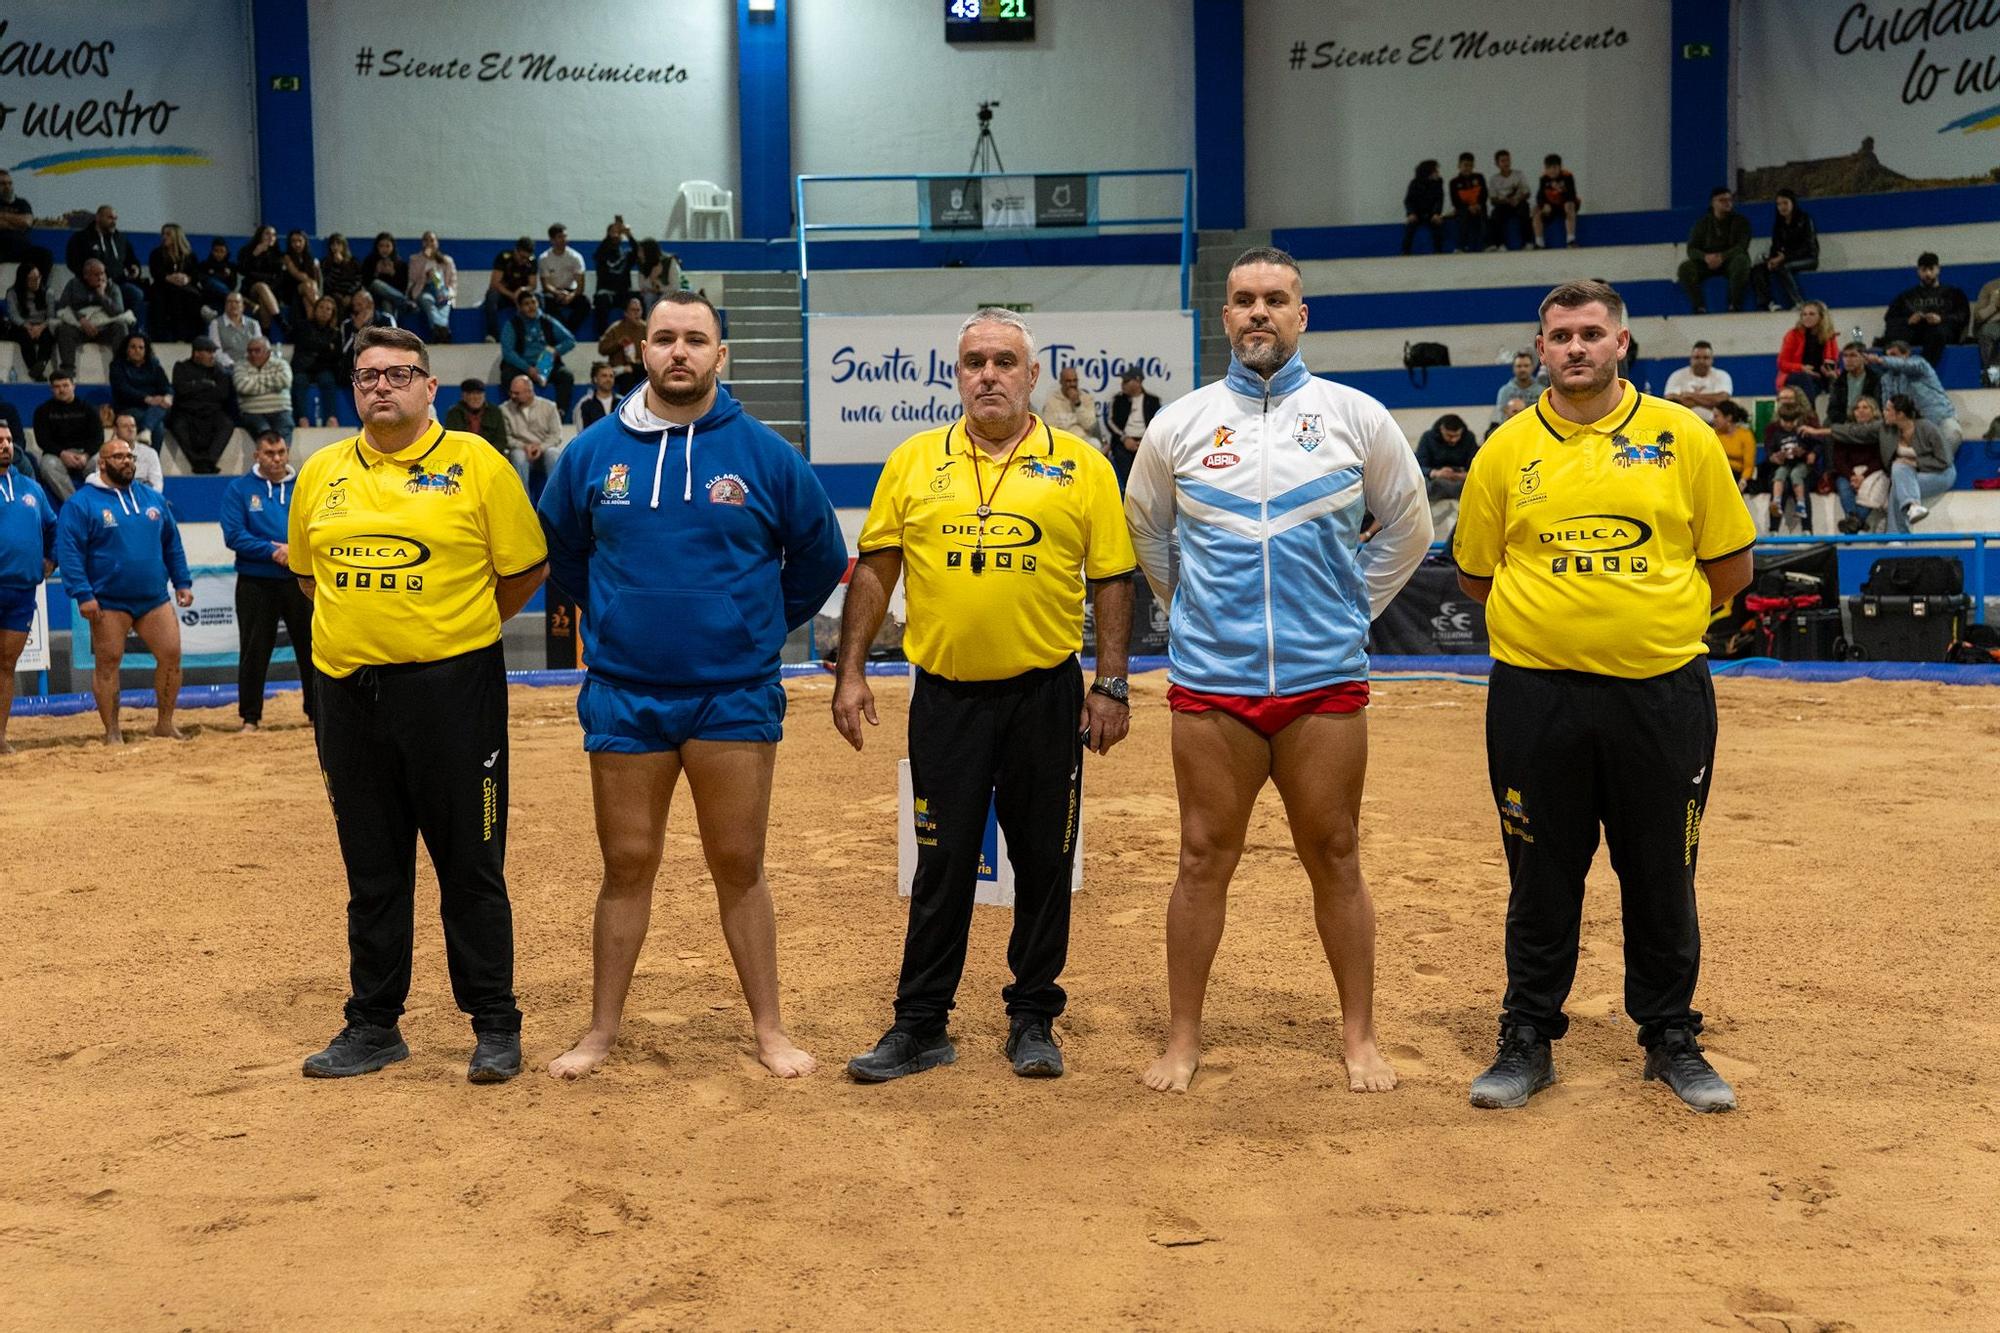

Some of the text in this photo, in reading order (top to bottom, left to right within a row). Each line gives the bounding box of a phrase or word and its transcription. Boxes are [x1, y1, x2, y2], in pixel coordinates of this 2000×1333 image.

[951, 0, 980, 18] 43
[1000, 0, 1026, 18] 21
[0, 20, 115, 78] amos
[355, 47, 688, 82] #Siente El Movimiento
[1289, 27, 1630, 69] #Siente El Movimiento
[1902, 49, 1950, 104] lo
[22, 89, 180, 141] nuestro
[831, 346, 921, 383] Santa
[923, 348, 954, 389] Lu
[841, 405, 884, 423] una
[1206, 455, 1237, 466] ABRIL
[330, 547, 408, 557] DIELCA
[1539, 528, 1629, 544] DIELCA
[483, 777, 492, 841] CANARIA
